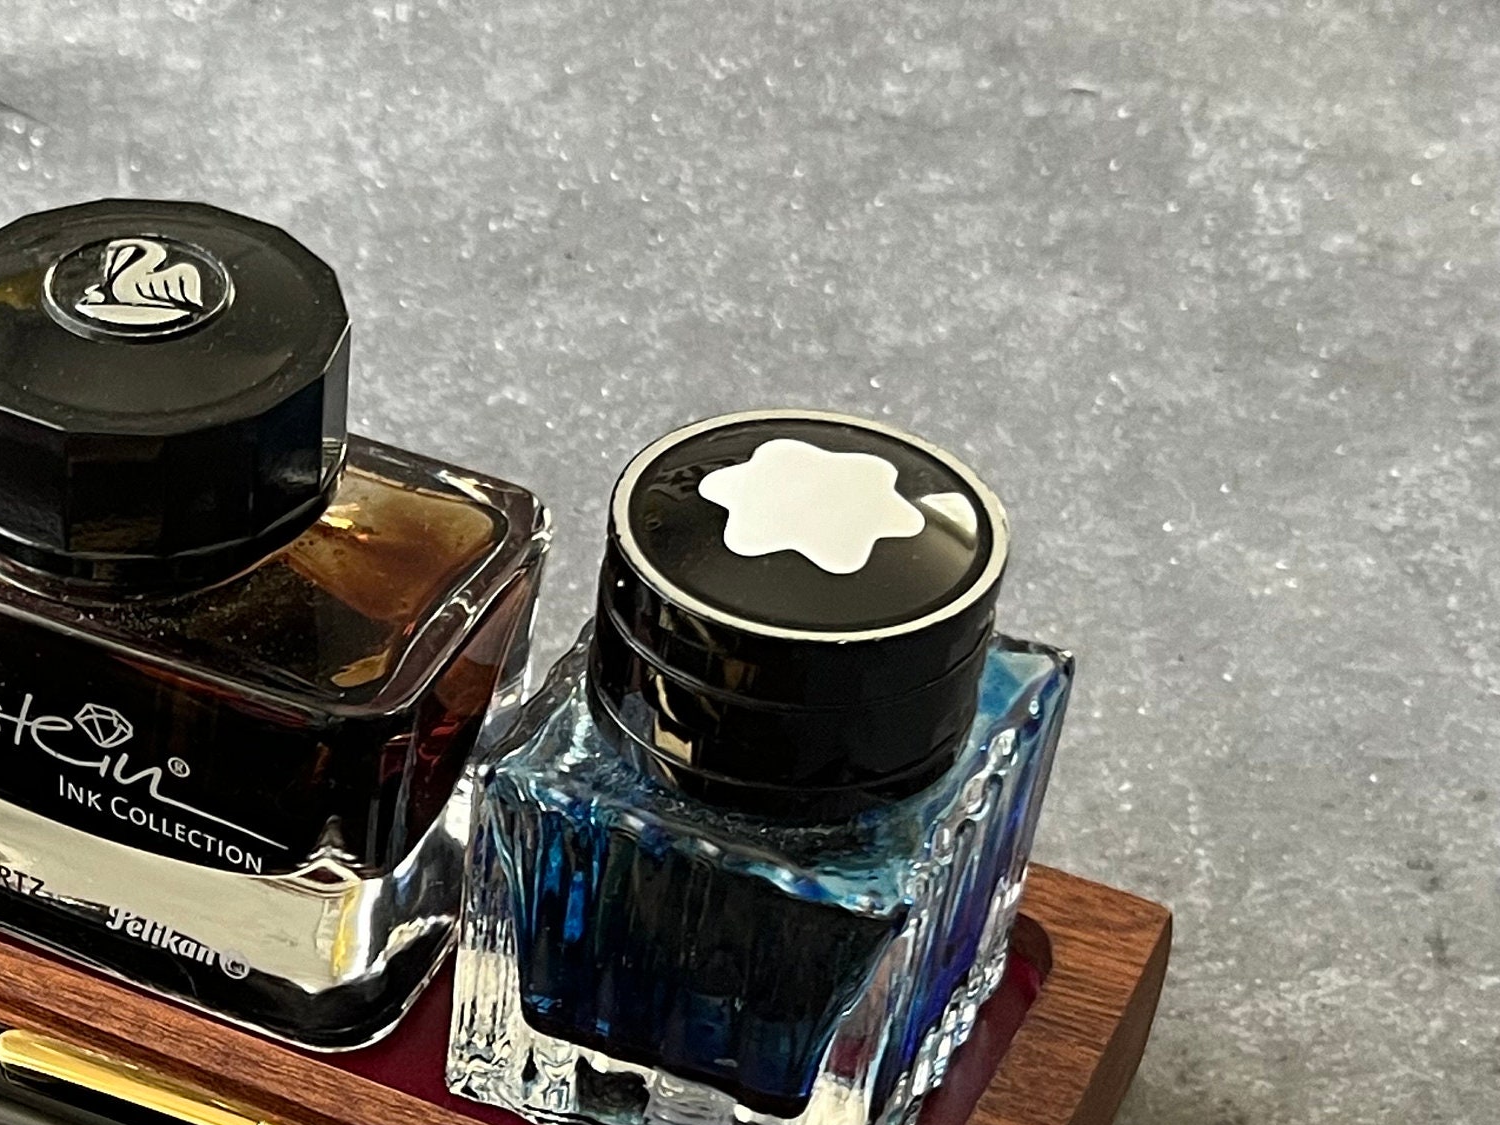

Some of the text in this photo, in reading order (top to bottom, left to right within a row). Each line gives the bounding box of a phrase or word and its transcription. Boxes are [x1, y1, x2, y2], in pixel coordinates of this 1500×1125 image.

[58, 773, 263, 875] INK COLLECTION
[105, 903, 217, 967] Pelikan
